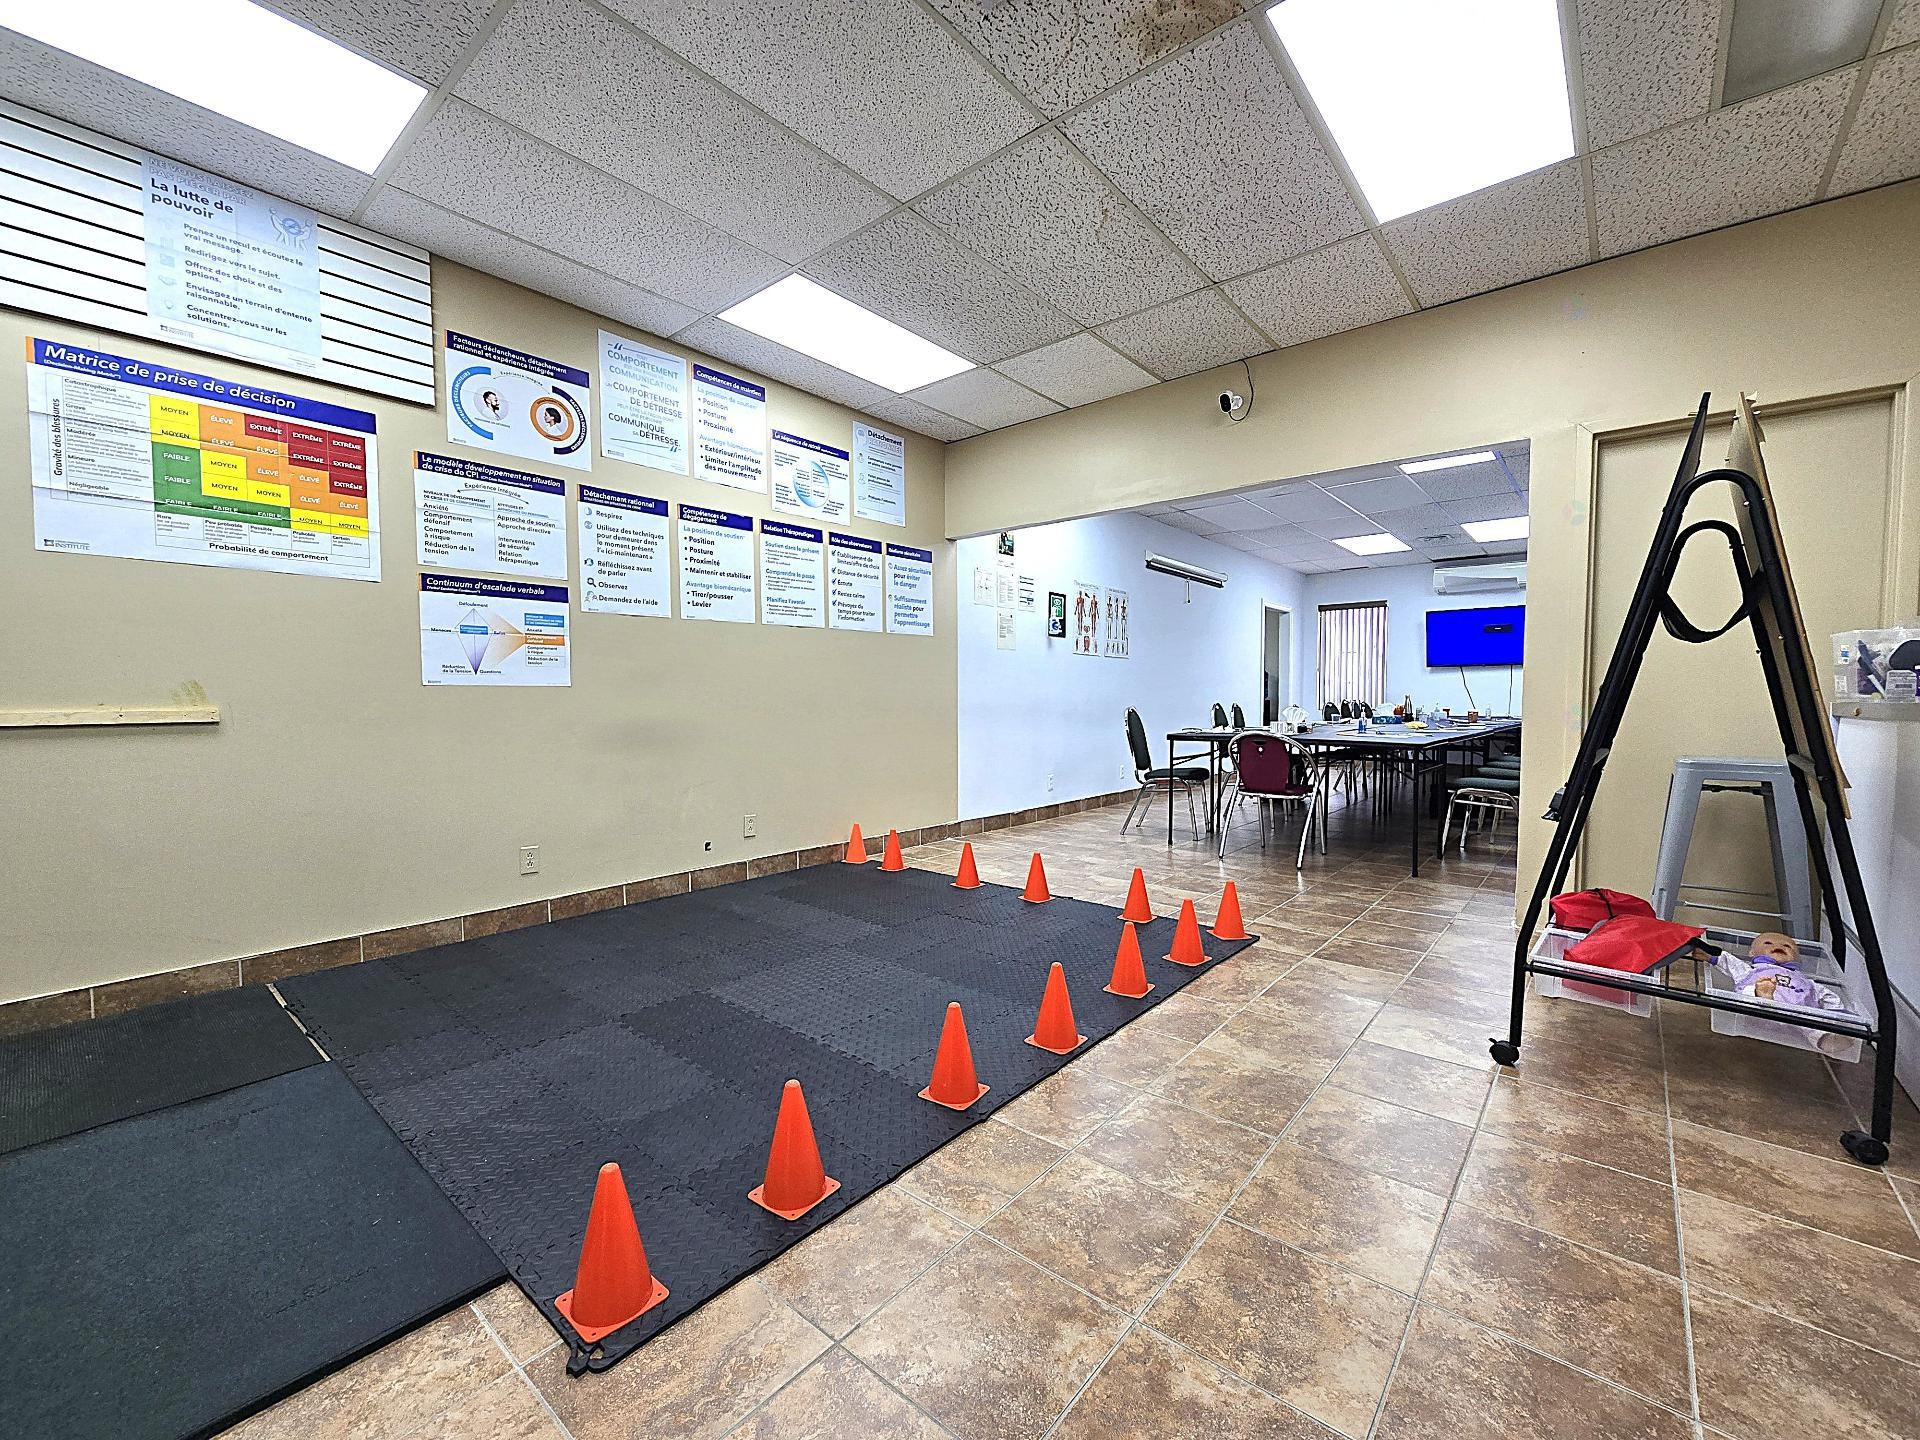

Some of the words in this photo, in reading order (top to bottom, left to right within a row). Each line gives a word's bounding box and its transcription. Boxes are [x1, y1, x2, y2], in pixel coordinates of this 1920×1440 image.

[151, 178, 168, 192] La
[174, 185, 209, 205] lutte
[214, 200, 233, 213] de
[151, 193, 214, 219] pouvoir
[184, 233, 201, 241] vrai
[202, 237, 244, 255] message.
[185, 260, 214, 274] Offrez
[216, 268, 231, 278] des
[233, 274, 256, 286] choix
[258, 282, 267, 290] et
[268, 284, 283, 293] des
[185, 269, 222, 284] options.
[186, 290, 240, 310] raisonnable.
[187, 304, 259, 329] Concentrez-vous
[261, 323, 274, 332] sur
[275, 326, 287, 336] les
[187, 313, 230, 328] solutions.
[453, 335, 482, 349] Facteurs
[528, 358, 567, 374] détachement
[453, 342, 484, 356] rationnel
[485, 350, 492, 358] et
[493, 353, 528, 369] expérience
[608, 350, 678, 379] COMPORTEMENT
[45, 344, 120, 372] Matrice
[125, 364, 149, 377] de
[154, 370, 198, 388] prise
[203, 381, 224, 394] de
[229, 386, 296, 410] décision
[609, 366, 678, 392] COMMUNICATION
[613, 382, 679, 407] COMPORTEMENT
[160, 406, 189, 416] MOYEN
[630, 397, 641, 406] DE
[644, 401, 683, 418] DÉTRESSE
[703, 398, 728, 411] Position
[52, 398, 62, 433] blessures
[703, 409, 727, 421] Posture
[608, 412, 665, 434] COMMUNIQUE
[704, 420, 734, 433] Proximité
[52, 434, 62, 448] des
[639, 430, 680, 447] DÉTRESSE.
[868, 430, 902, 446] Détachement
[163, 452, 191, 461] FAIBLE
[705, 445, 761, 464] Extérieur/intérieur
[53, 449, 63, 476] Gravité
[210, 460, 237, 469] MOYEN
[705, 455, 728, 466] Limiter
[728, 461, 762, 475] l'amplitude
[422, 462, 433, 470] de
[466, 470, 479, 478] CPI
[433, 458, 463, 469] modèle
[465, 463, 521, 481] développement
[532, 475, 561, 487] situation
[705, 463, 716, 471] des
[718, 467, 756, 480] mouvements
[164, 475, 191, 484] FAIBLE
[211, 483, 239, 491] MOYEN
[256, 489, 281, 498] MOYEN
[424, 511, 472, 523] Comportement
[596, 510, 622, 520] Respirez
[683, 507, 719, 519] Compétences
[497, 514, 525, 525] Approche
[536, 521, 556, 529] soutien
[424, 526, 473, 538] Comportement
[498, 522, 526, 532] Approche
[527, 526, 550, 535] directive
[597, 524, 619, 533] Utilisez
[633, 530, 664, 540] techniques
[424, 541, 457, 550] Réduction
[498, 536, 536, 546] Interventions
[613, 535, 642, 544] demeurer
[689, 536, 715, 546] Position
[765, 541, 784, 549] Soutien
[209, 542, 257, 553] Probabilité
[272, 549, 328, 561] comportement
[498, 550, 522, 558] Relation
[690, 546, 713, 555] Posture
[598, 561, 635, 571] Réfléchissez
[690, 557, 720, 566] Proximité
[690, 567, 718, 576] Maintenir
[727, 570, 751, 580] stabiliser
[766, 568, 795, 578] Comprendre
[863, 572, 879, 580] sécurité
[427, 578, 472, 589] Continuum
[475, 582, 516, 593] d'escalade
[518, 586, 544, 595] verbale
[598, 582, 627, 590] Observez
[599, 595, 632, 604] Demandez
[691, 590, 733, 600] Tirer/pousser
[692, 600, 711, 608] Levier
